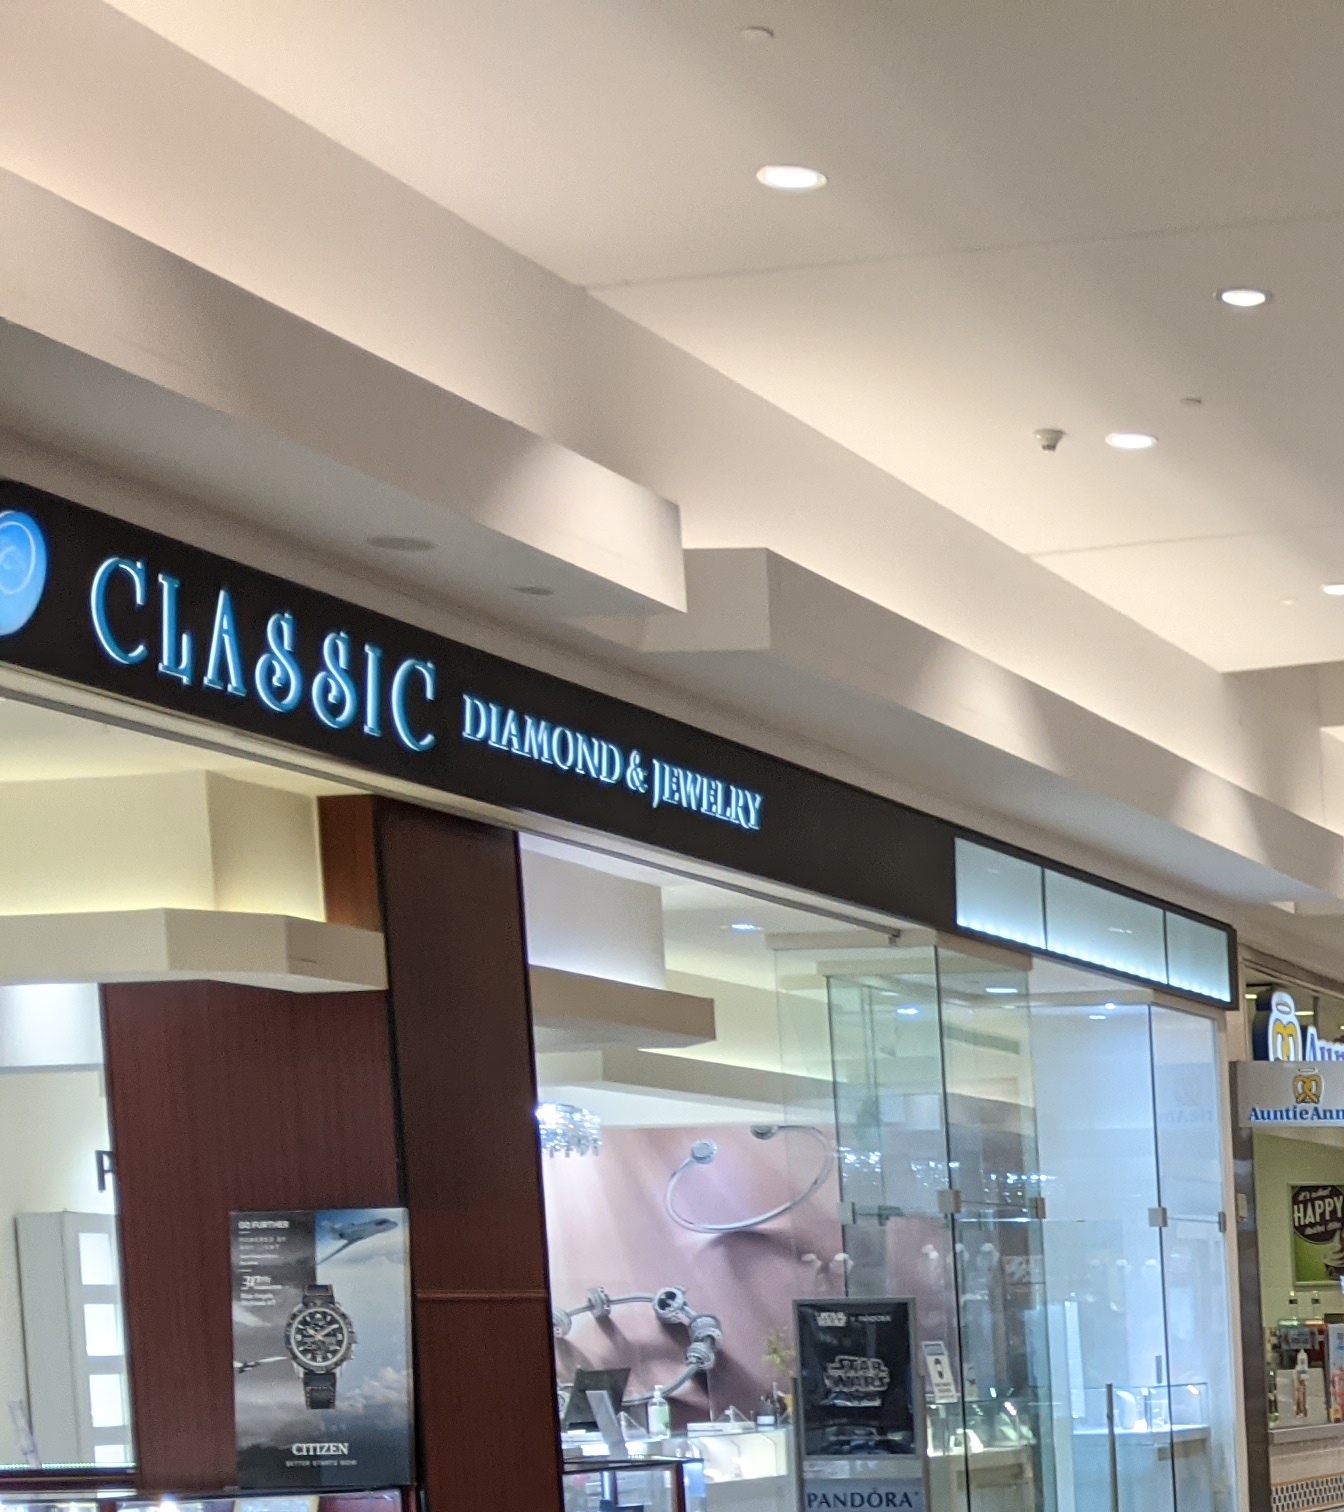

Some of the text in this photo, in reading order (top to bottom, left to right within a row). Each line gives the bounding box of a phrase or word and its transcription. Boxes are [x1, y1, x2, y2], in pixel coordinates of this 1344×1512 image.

[90, 556, 763, 831] CLASSIC DIAMOND & JEWELRY
[1293, 1195, 1344, 1228] HAPPY
[826, 1355, 886, 1373] STAR
[824, 1373, 891, 1392] WARS
[292, 1442, 349, 1456] CITIZEN
